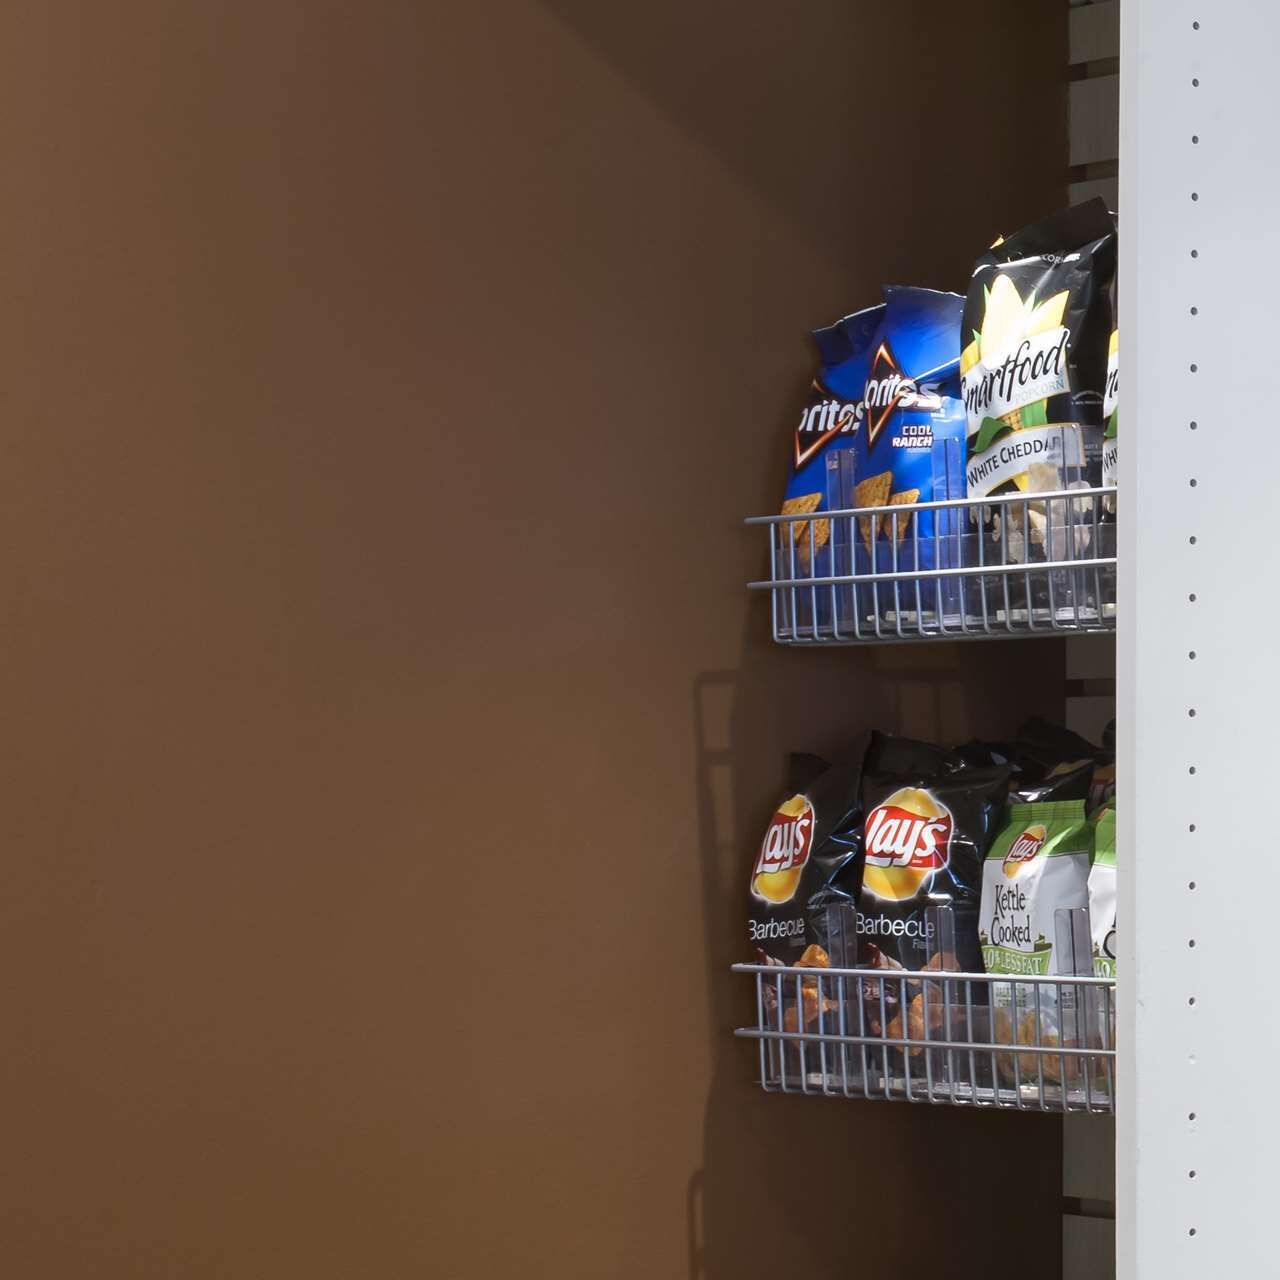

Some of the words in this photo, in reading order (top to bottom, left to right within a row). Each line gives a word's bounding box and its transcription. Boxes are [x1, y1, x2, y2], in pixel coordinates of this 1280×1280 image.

[865, 374, 942, 410] oritos
[798, 400, 865, 432] oritos
[902, 425, 933, 436] COOL
[892, 437, 933, 447] RANCH
[968, 454, 999, 487] WHITE
[757, 813, 808, 872] Lay's
[866, 808, 947, 867] Lay's
[994, 883, 1026, 919] Kettle
[749, 917, 805, 940] Barbecue
[856, 912, 935, 938] Barbecue
[991, 913, 1032, 946] Cooked
[1001, 953, 1021, 973] LESS
[1022, 957, 1044, 975] FAT
